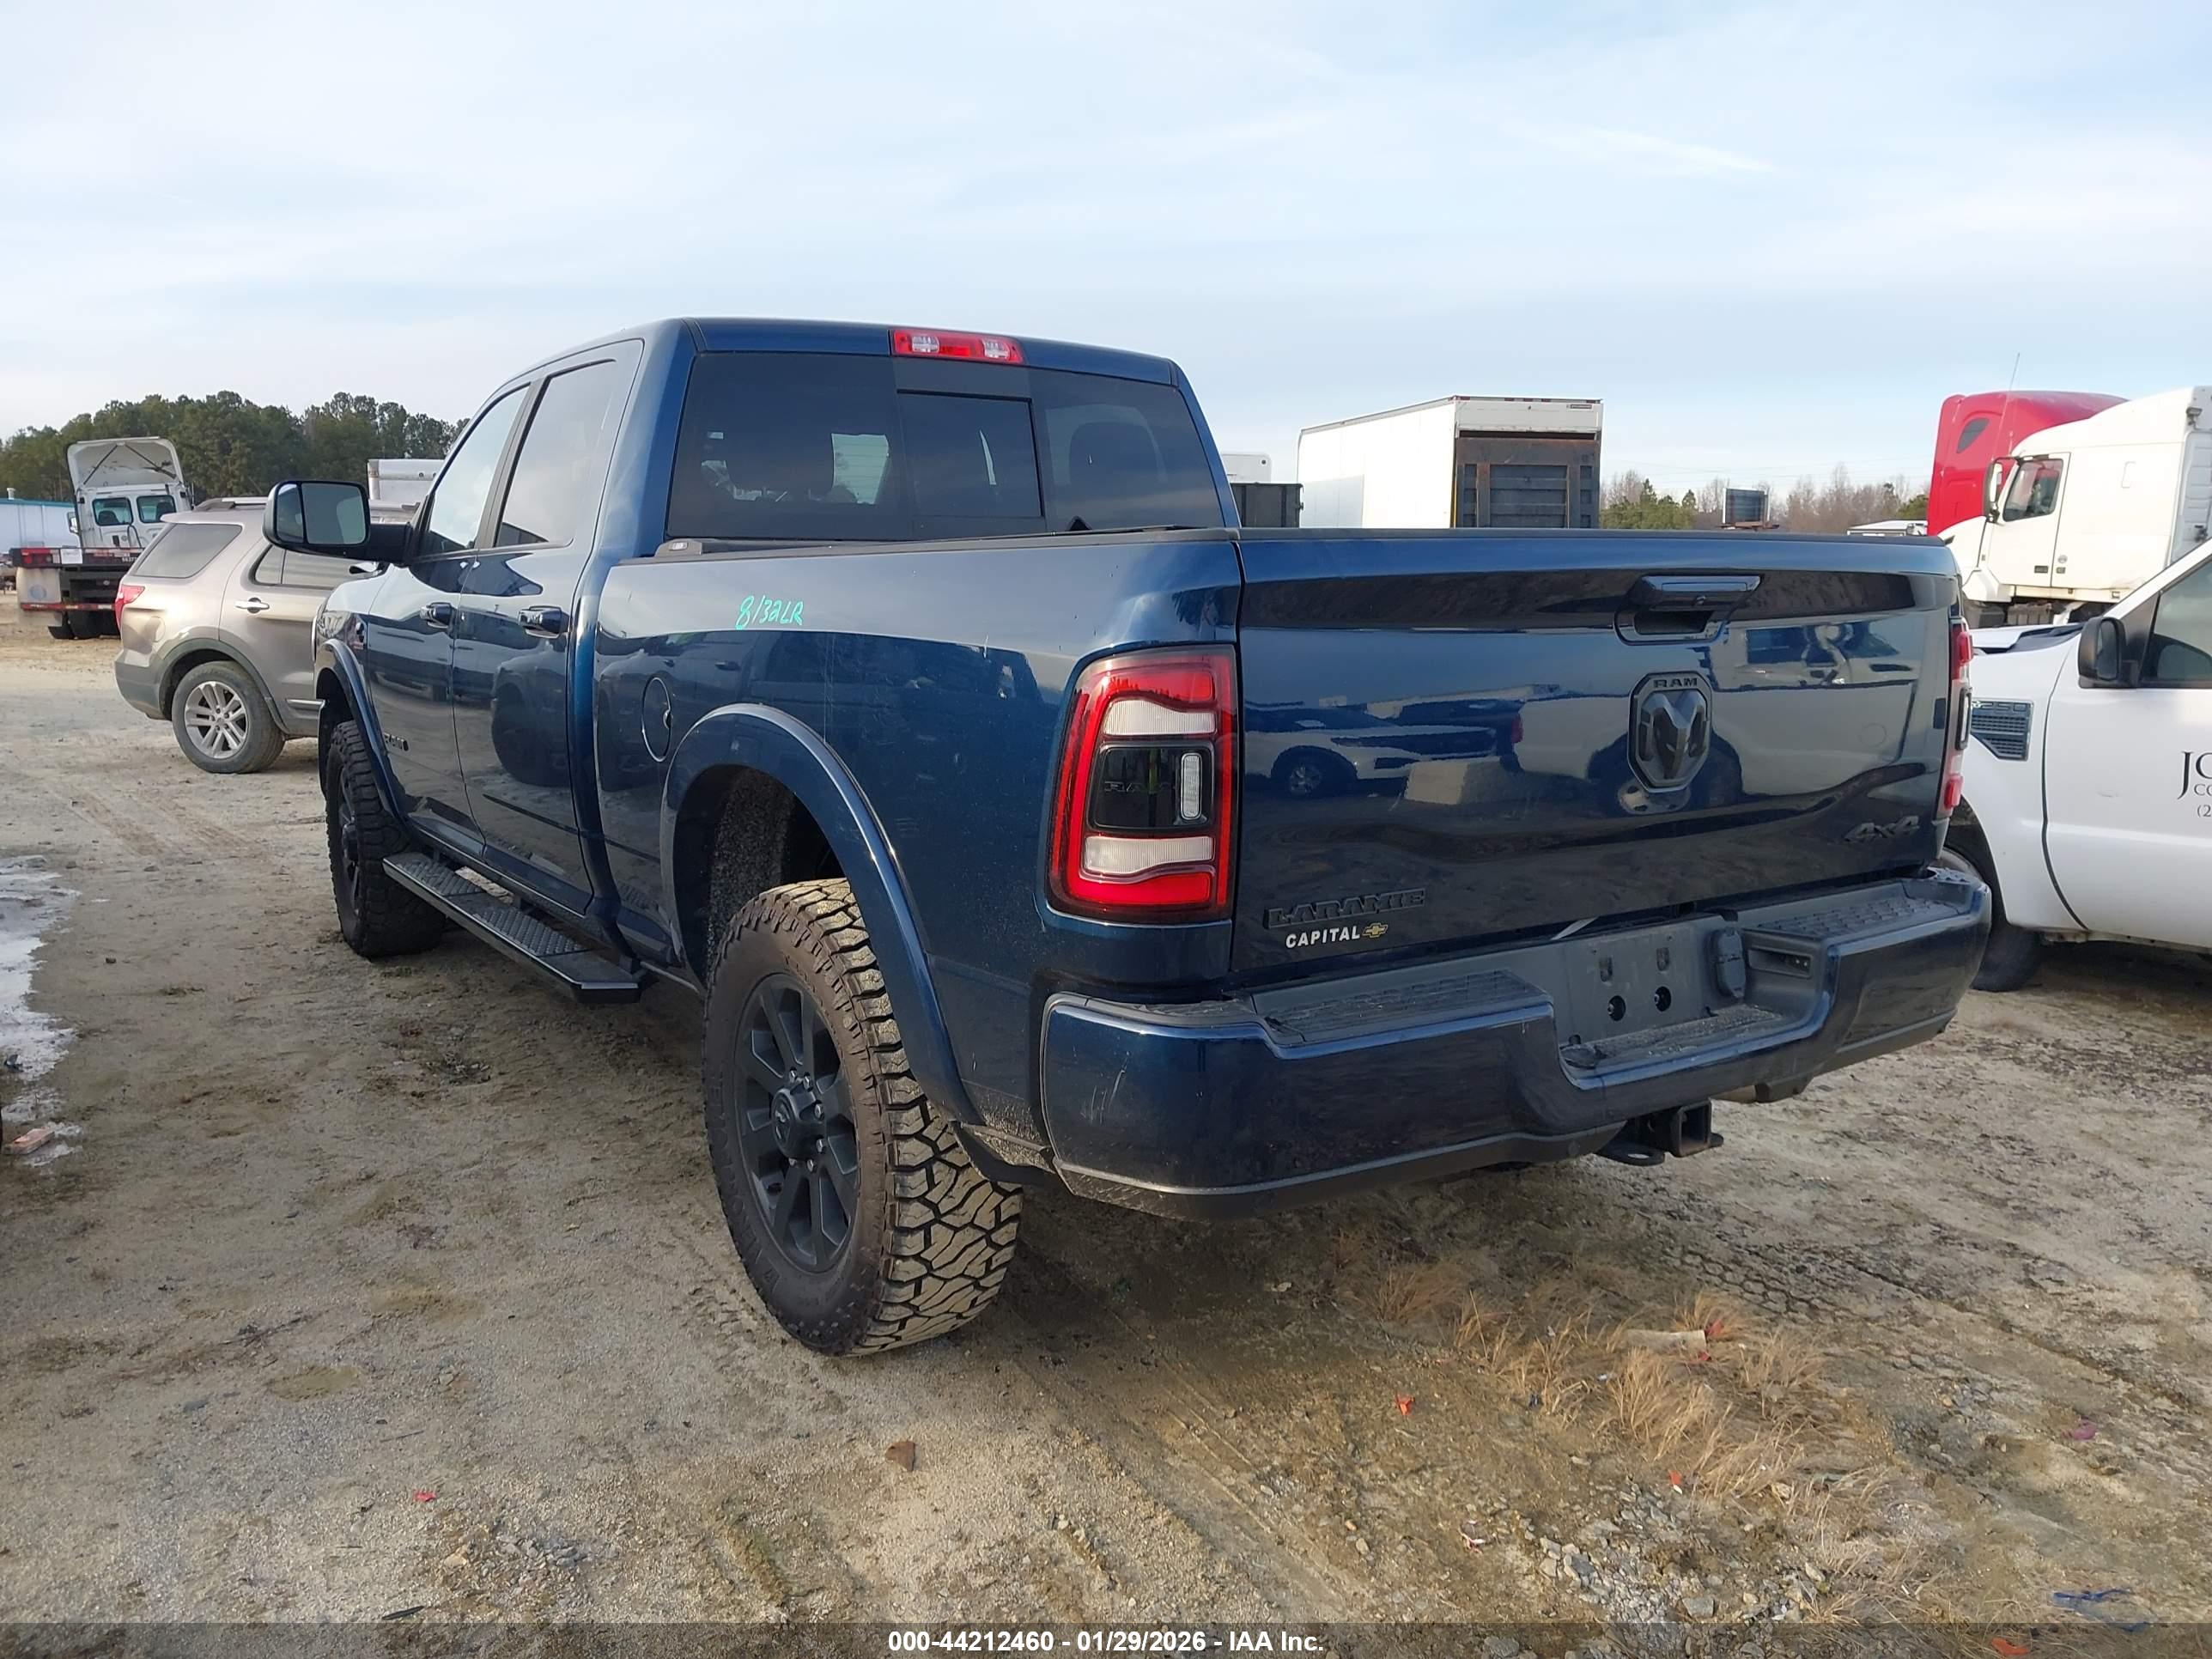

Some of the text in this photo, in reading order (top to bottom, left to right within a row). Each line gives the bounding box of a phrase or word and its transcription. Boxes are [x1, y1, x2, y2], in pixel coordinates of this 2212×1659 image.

[1653, 678, 1698, 688] RAM
[1262, 888, 1425, 929] LARAMIE
[1285, 926, 1361, 948] CAPITAL
